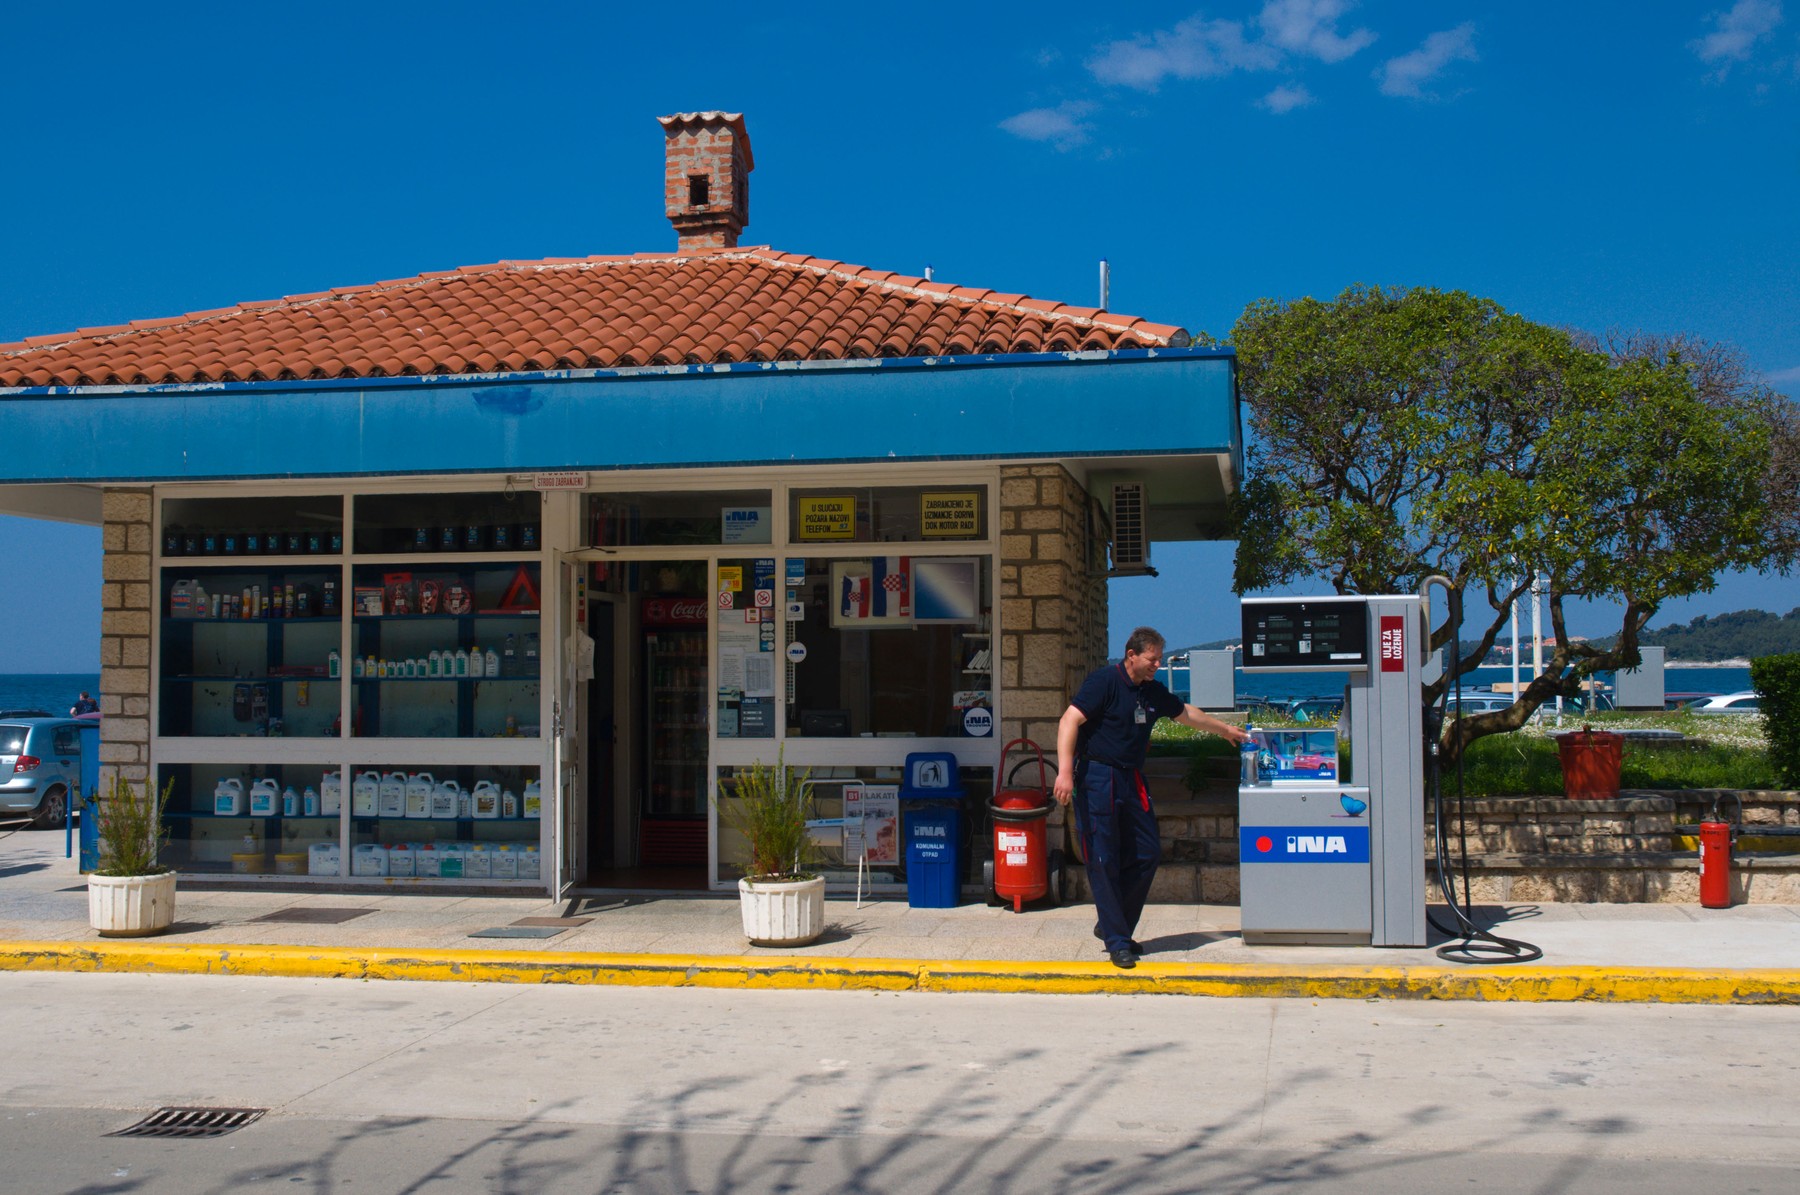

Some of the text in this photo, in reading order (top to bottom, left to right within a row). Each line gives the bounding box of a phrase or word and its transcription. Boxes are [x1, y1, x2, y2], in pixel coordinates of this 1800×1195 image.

[811, 503, 816, 512] U
[925, 499, 974, 509] ZABRANJENO JE
[829, 513, 850, 523] NAZOVI
[924, 510, 974, 519] UZIMANJE GORIVA
[805, 524, 831, 533] TELEFON
[925, 521, 974, 530] DOK MOTOR RADI
[1382, 630, 1392, 659] ULJE ZA
[1392, 628, 1402, 660] LOŽENJE
